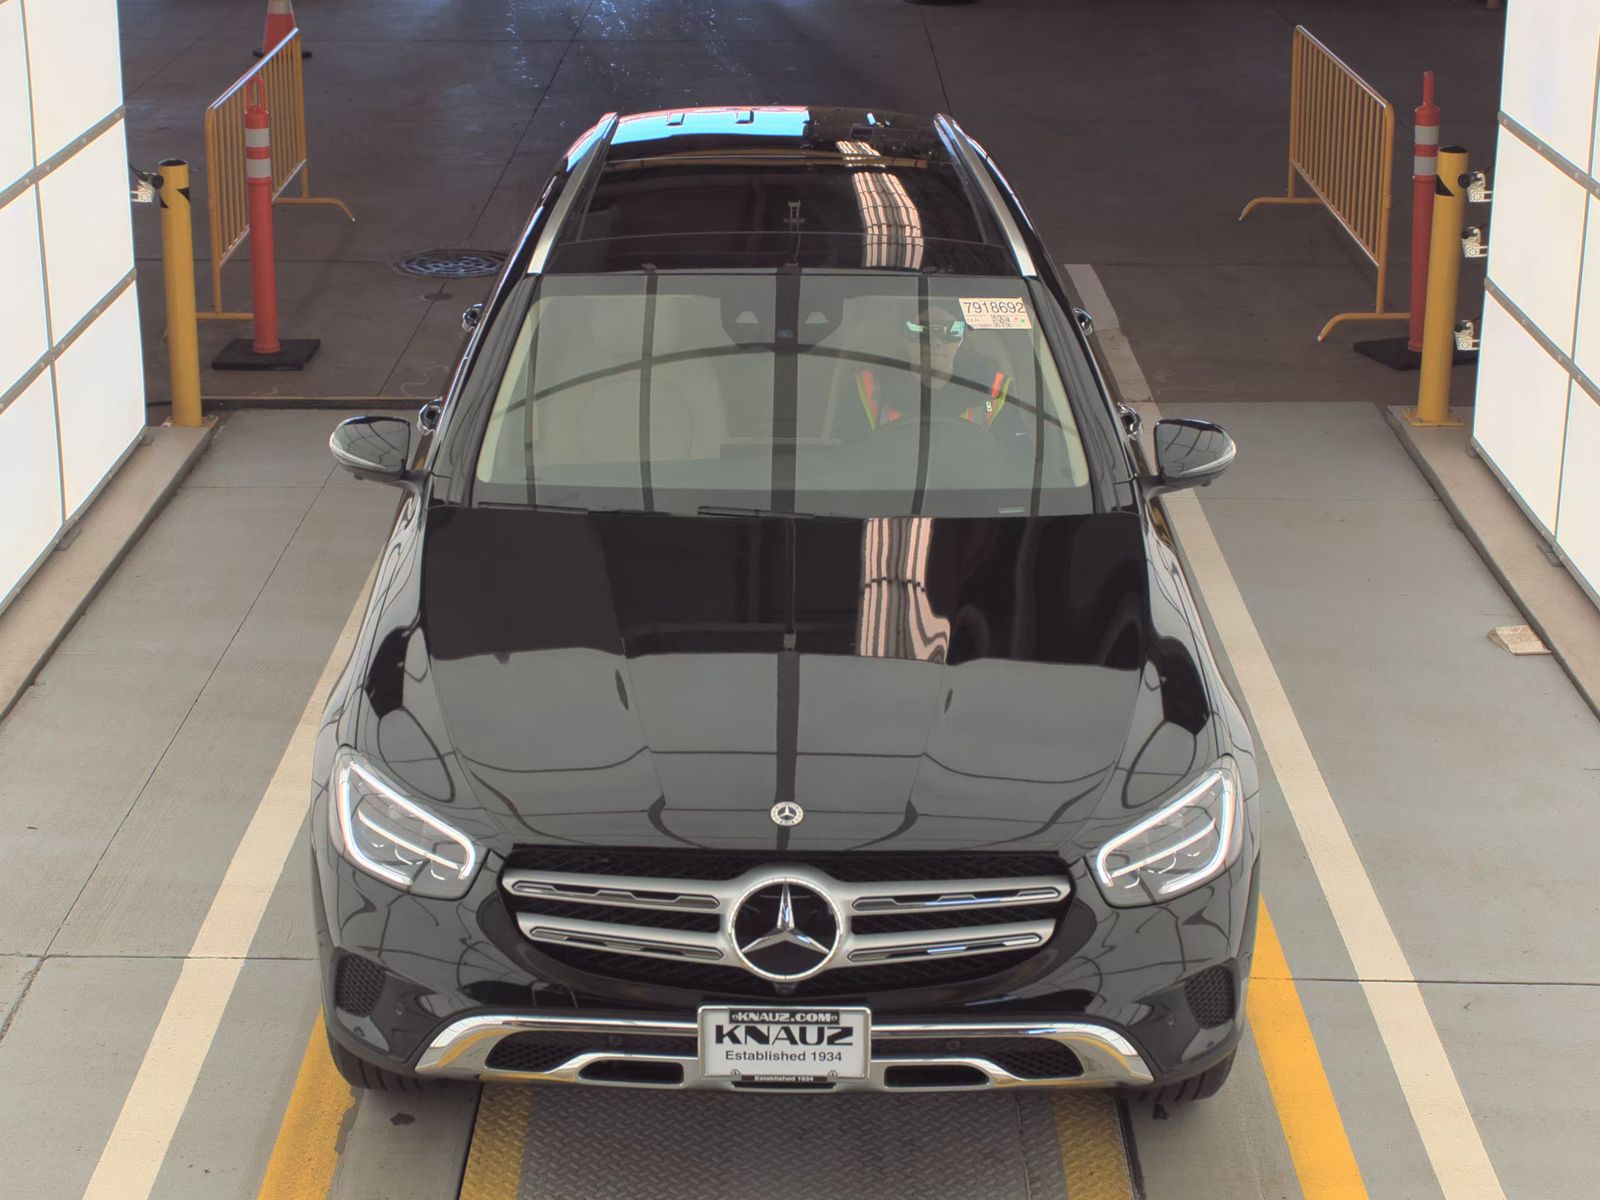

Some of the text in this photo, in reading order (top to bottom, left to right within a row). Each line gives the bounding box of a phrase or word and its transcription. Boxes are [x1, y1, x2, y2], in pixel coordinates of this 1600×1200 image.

[963, 302, 1026, 314] 7918692
[737, 1012, 831, 1022] KNAUZ.COM
[715, 1024, 854, 1046] KNAUZ
[725, 1050, 842, 1062] Established 1934
